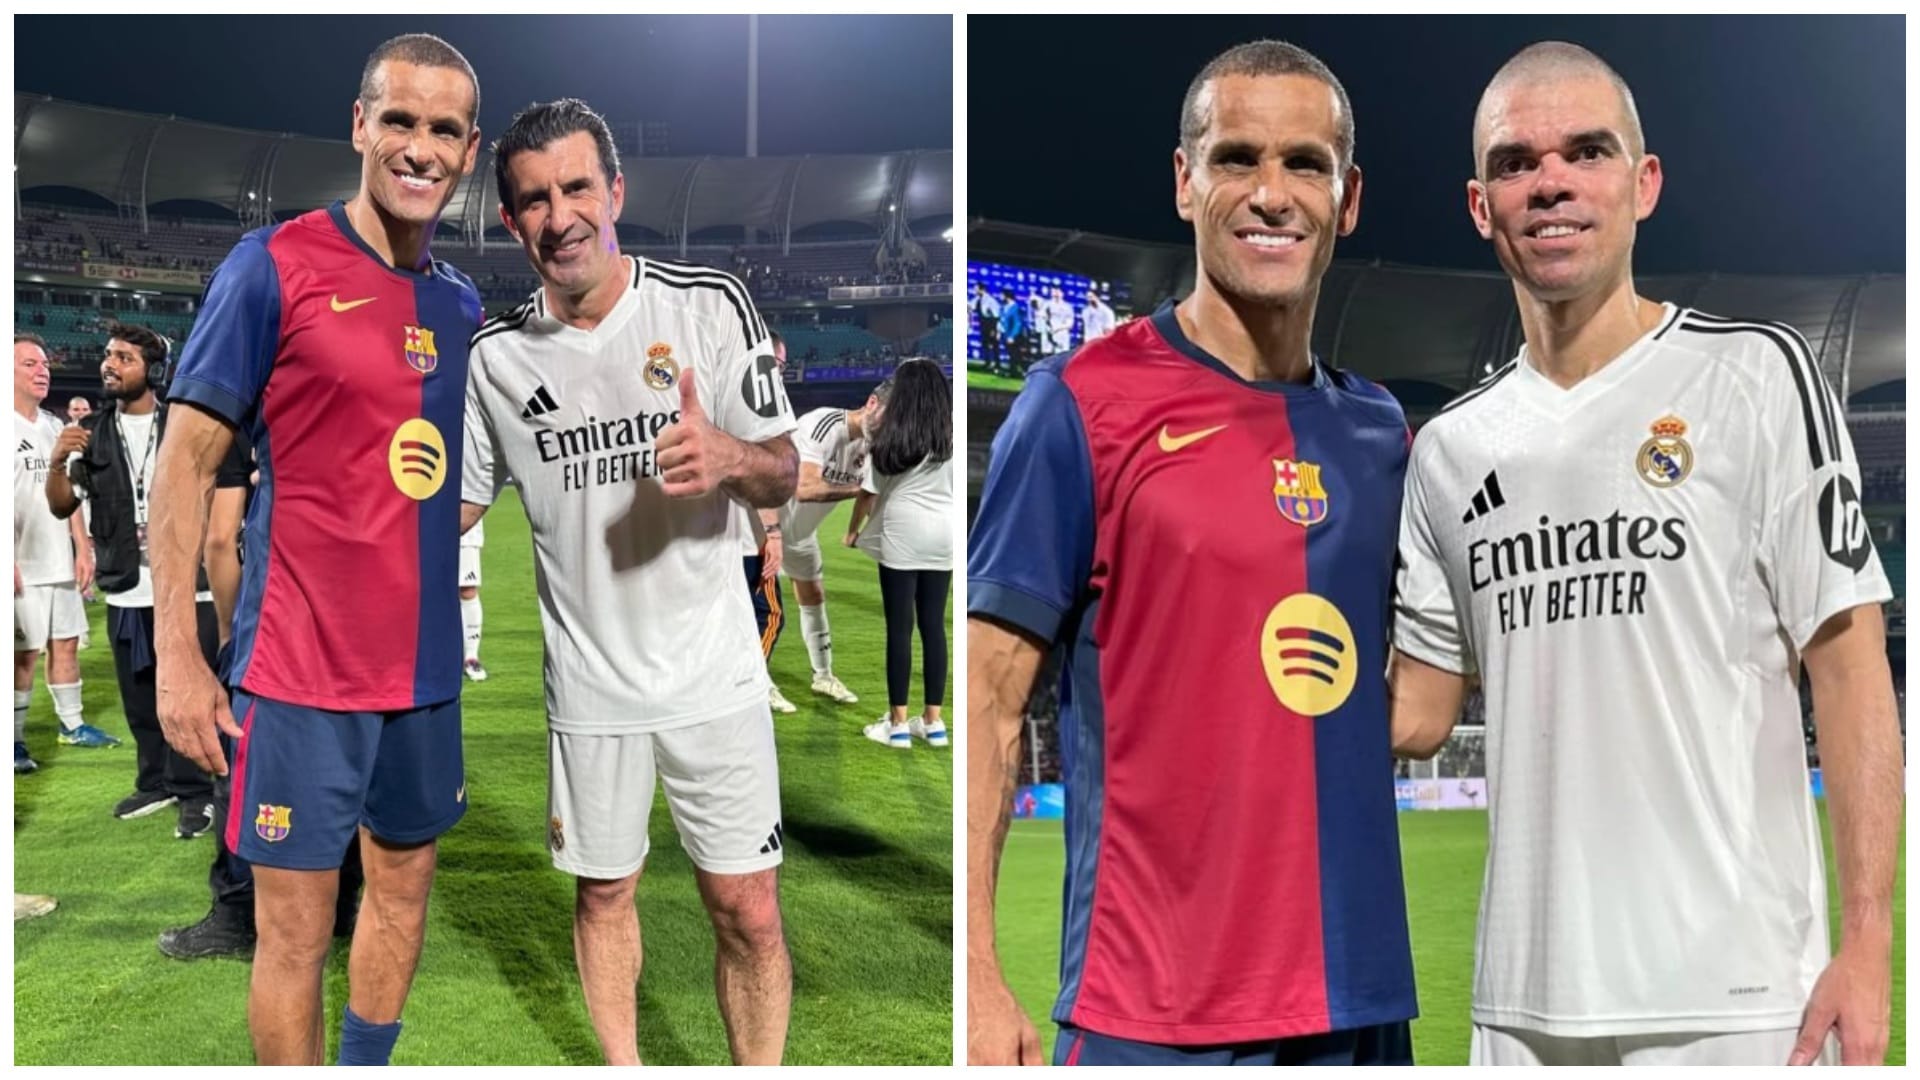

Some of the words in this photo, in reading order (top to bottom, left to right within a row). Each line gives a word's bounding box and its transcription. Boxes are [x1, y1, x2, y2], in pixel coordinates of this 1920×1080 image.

[564, 459, 589, 492] FLY
[1468, 509, 1687, 592] Emirates
[1498, 584, 1535, 635] FLY
[1546, 571, 1647, 624] BETTER
